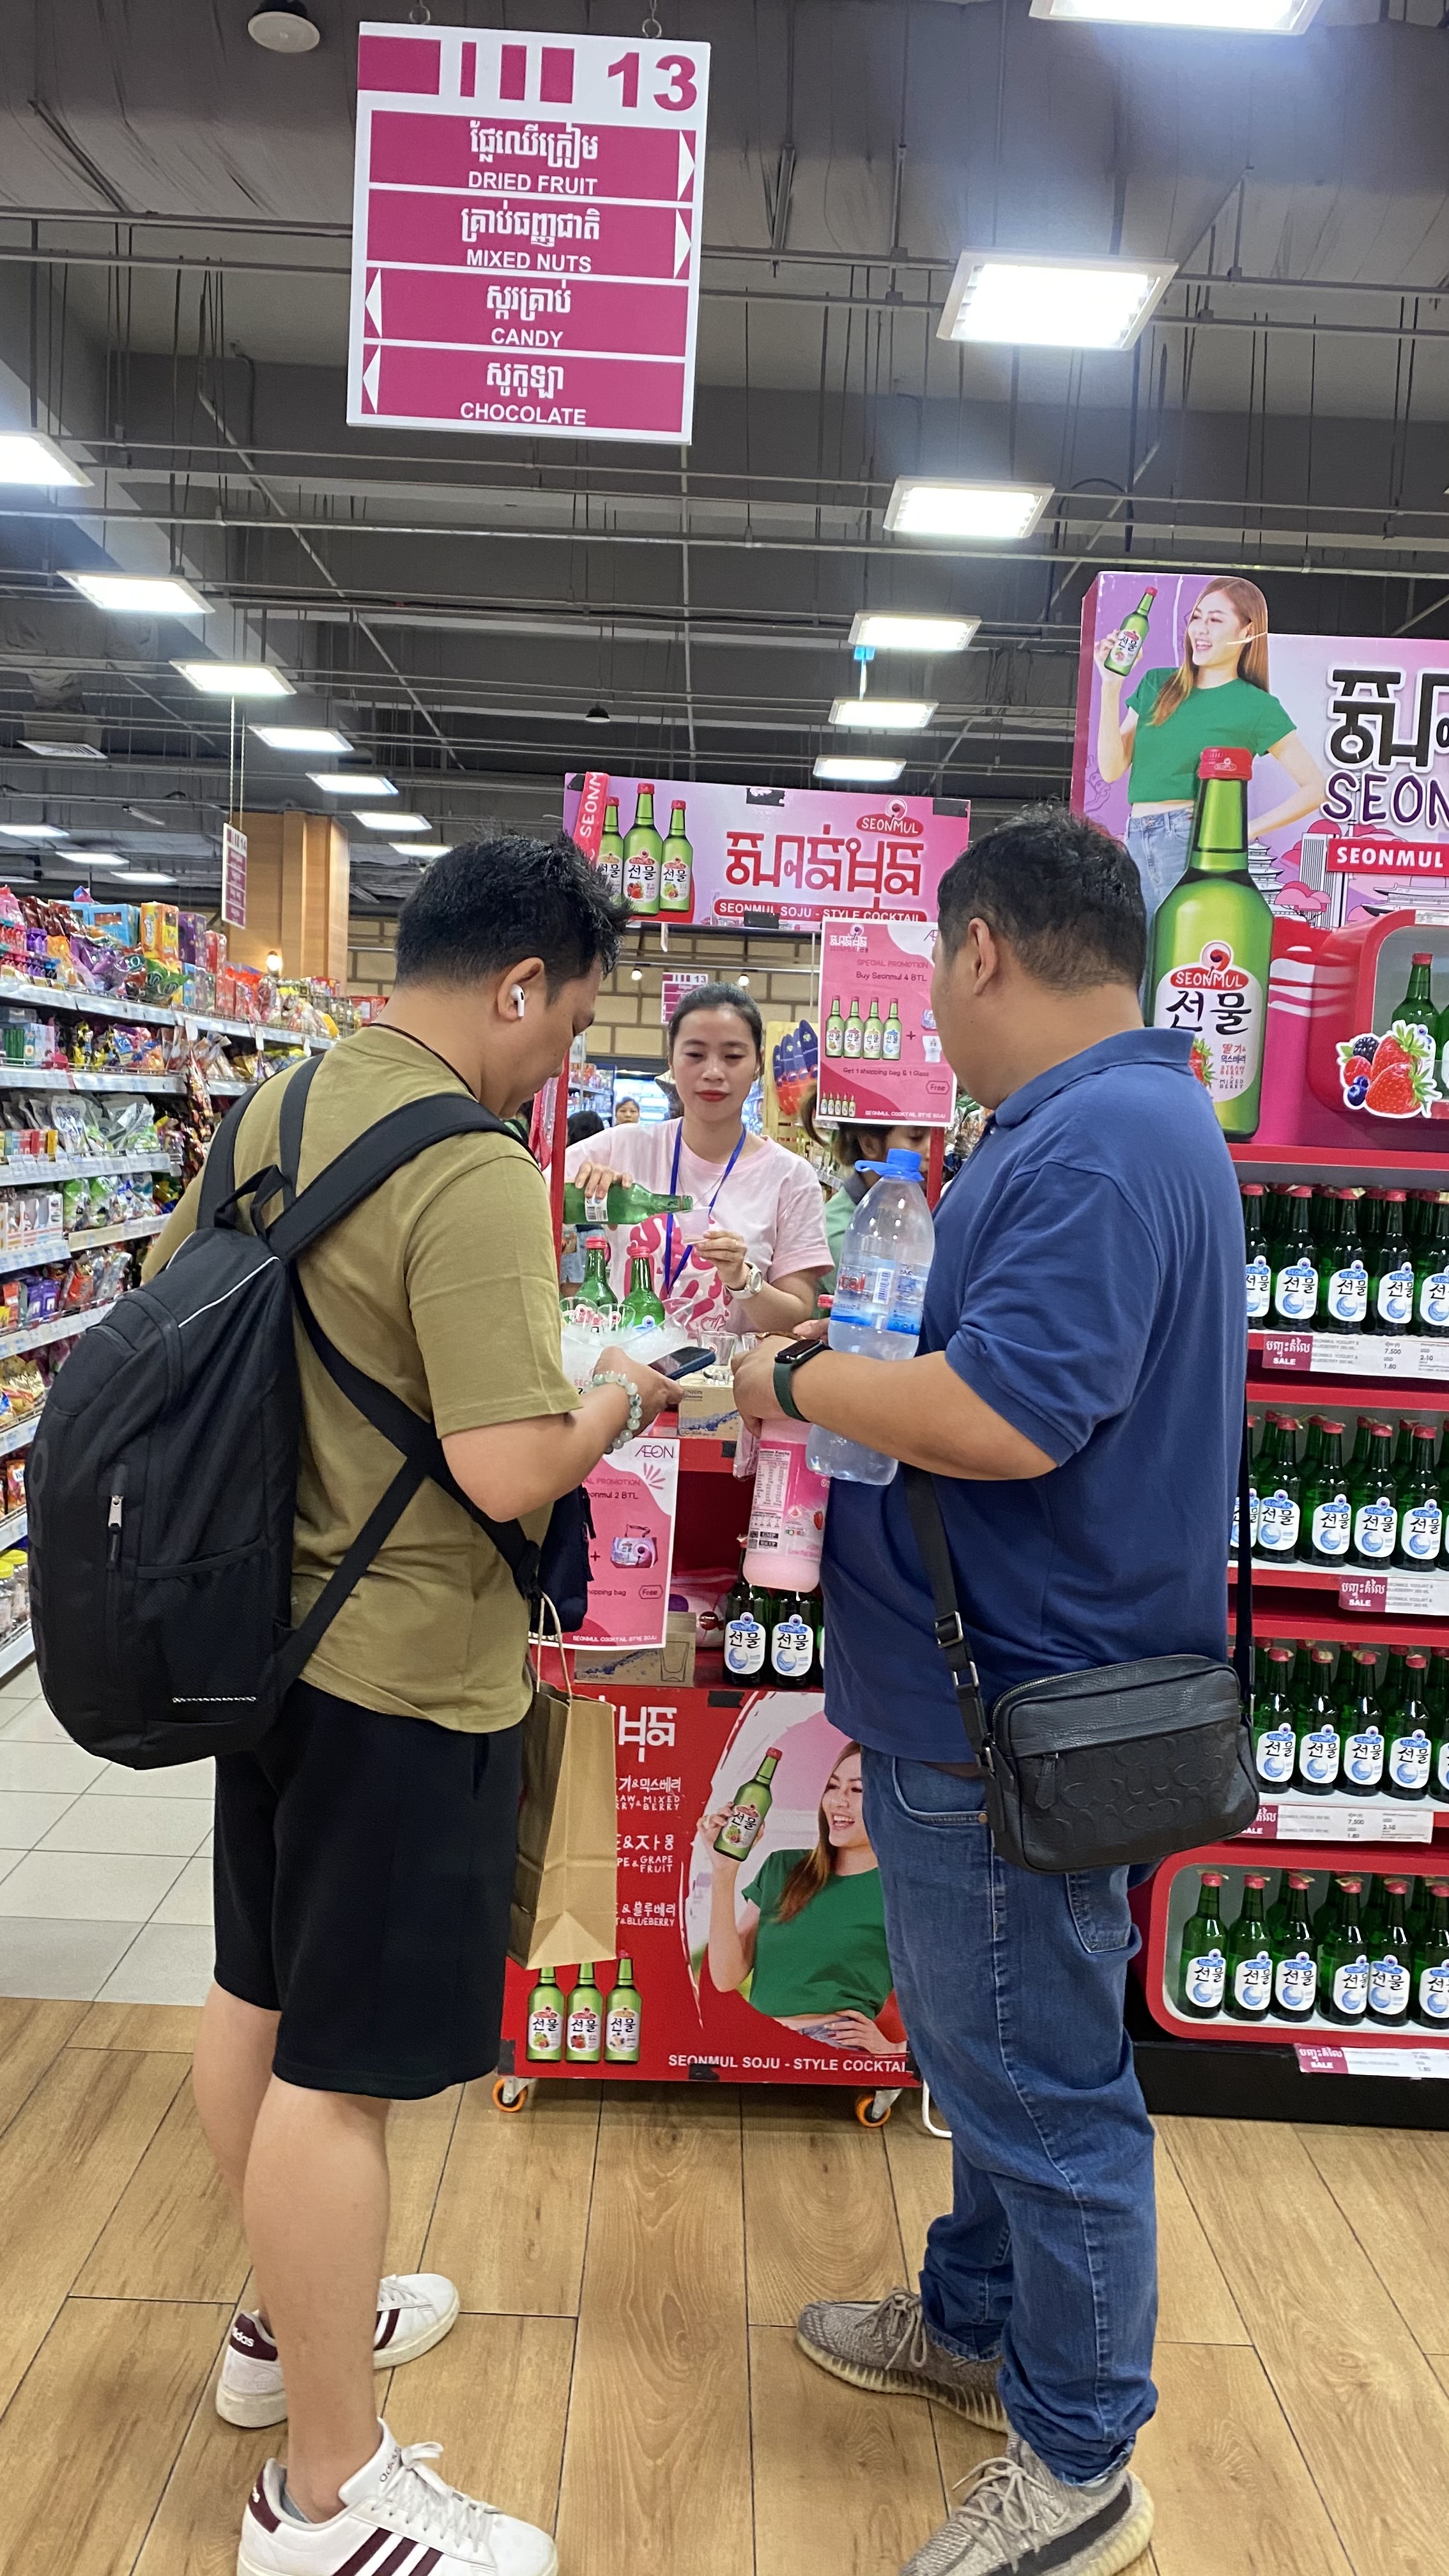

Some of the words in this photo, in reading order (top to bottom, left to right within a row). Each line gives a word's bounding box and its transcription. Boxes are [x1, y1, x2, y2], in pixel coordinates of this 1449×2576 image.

[608, 52, 698, 111] 13
[470, 121, 598, 168] ផ្លែឈើក្រៀម
[468, 171, 531, 192] DRIED
[537, 175, 598, 195] FRUIT
[466, 250, 530, 270] MIXED
[537, 253, 592, 273] NUTS
[491, 328, 564, 348] CANDY
[486, 362, 564, 399] សូកូឡា
[460, 402, 586, 425] CHOCOLATE
[862, 818, 919, 833] SEONMUL
[1337, 847, 1443, 868] SEONMUL
[628, 864, 657, 880] 선물
[781, 907, 812, 918] SOJU
[887, 960, 929, 969] PROMOTION
[856, 971, 870, 979] Buy
[872, 972, 903, 980] Seonmul
[1175, 970, 1244, 988] SEONMUL
[1165, 990, 1252, 1035] 선물
[1284, 1276, 1315, 1294] 선물
[1337, 1279, 1367, 1296] 선물
[1386, 1282, 1414, 1298] 선물
[1429, 1284, 1449, 1300] 선
[1262, 1507, 1294, 1526] 선물
[1321, 1513, 1350, 1529] 선물
[1362, 1515, 1394, 1533] 선물
[1410, 1517, 1440, 1534] 선물
[729, 1630, 760, 1649] 선물
[777, 1632, 809, 1651] 선물
[1264, 1741, 1293, 1757] 선물
[1307, 1742, 1338, 1759] 선물
[1352, 1744, 1382, 1760] 선물
[1398, 1747, 1429, 1764] 선물
[732, 1812, 756, 1830] 선물
[640, 1855, 673, 1864] GRAPE
[640, 1864, 673, 1873] FRUIT
[1194, 1965, 1223, 1982] 선물
[1243, 1969, 1271, 1985] 선물
[1283, 1970, 1313, 1986] 선물
[1372, 1970, 1404, 1991] 선물
[532, 2018, 559, 2031] 선물
[571, 2019, 598, 2032] 선물
[611, 2018, 636, 2032] 선물
[742, 2057, 780, 2069] SOJU
[793, 2058, 838, 2071] STYLE
[843, 2060, 905, 2072] COCKTAI
